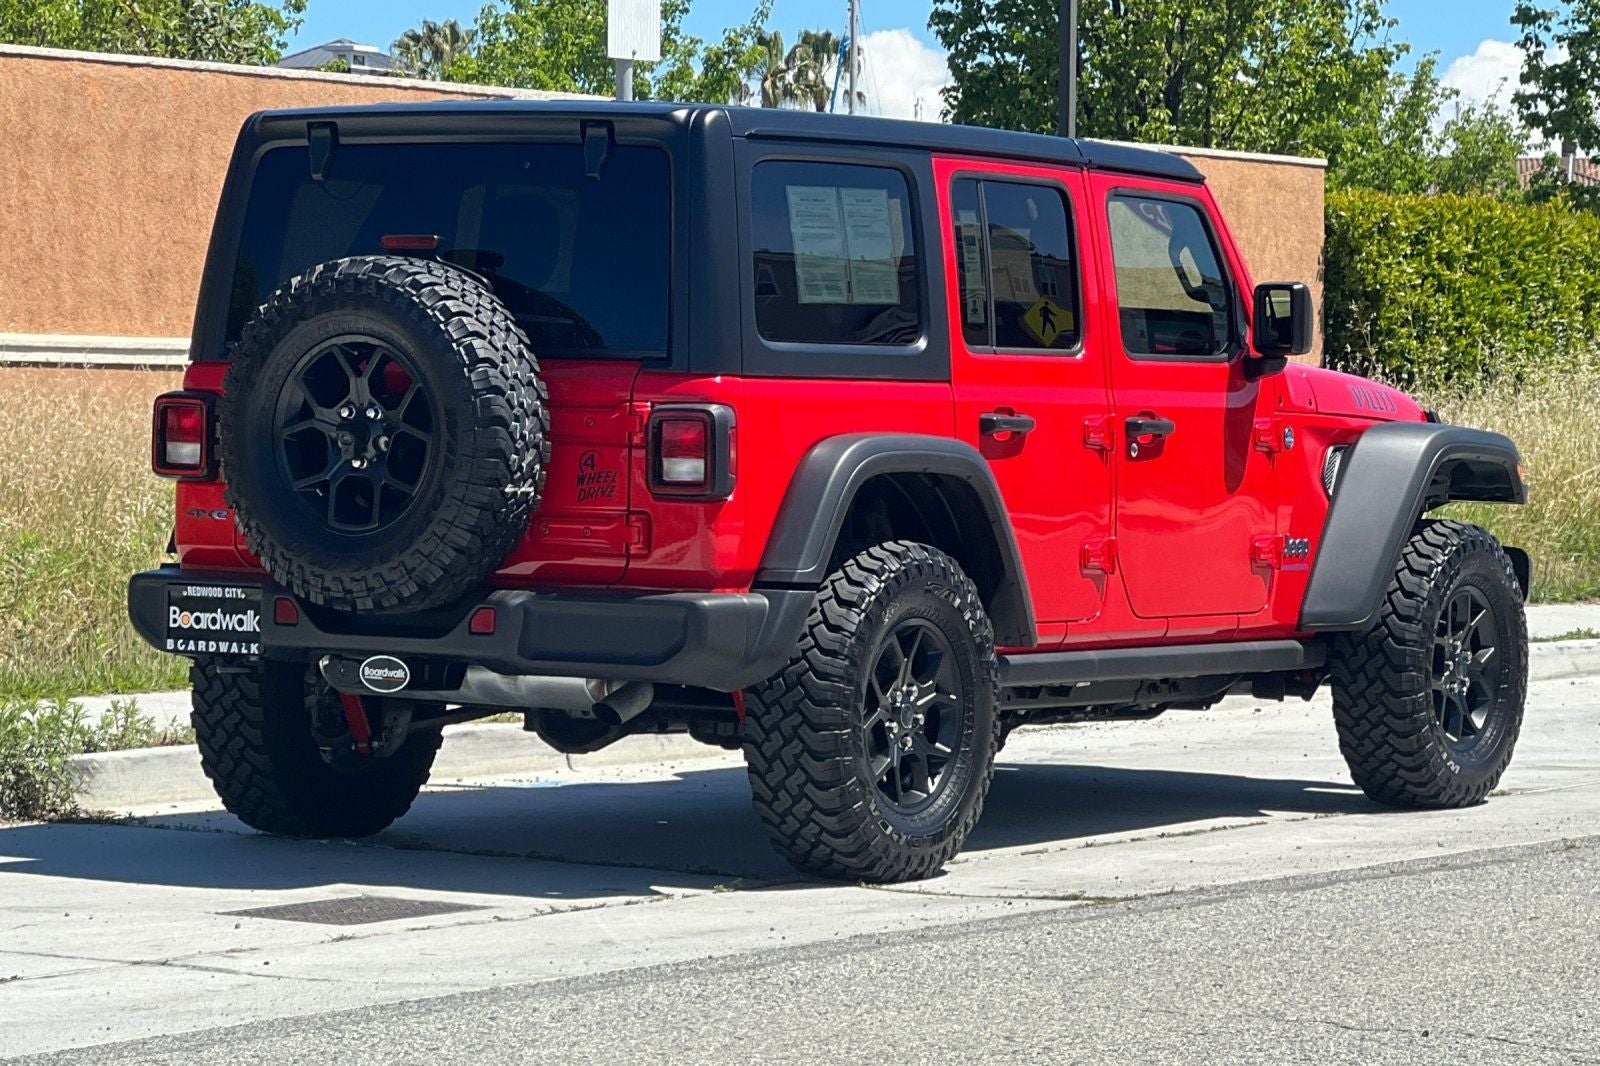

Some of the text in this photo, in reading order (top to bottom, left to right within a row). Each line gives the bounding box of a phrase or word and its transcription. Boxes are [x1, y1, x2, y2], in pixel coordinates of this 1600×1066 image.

[1348, 384, 1396, 412] WILLYS
[583, 453, 595, 471] 4
[576, 471, 617, 487] WHEEL
[576, 486, 615, 502] DRIVE
[1283, 534, 1309, 560] Jeep
[187, 586, 242, 599] REDWOOD CITY
[169, 605, 261, 632] Boardwalk
[166, 638, 259, 655] BOARDWALK
[364, 666, 405, 678] Boardwalk
